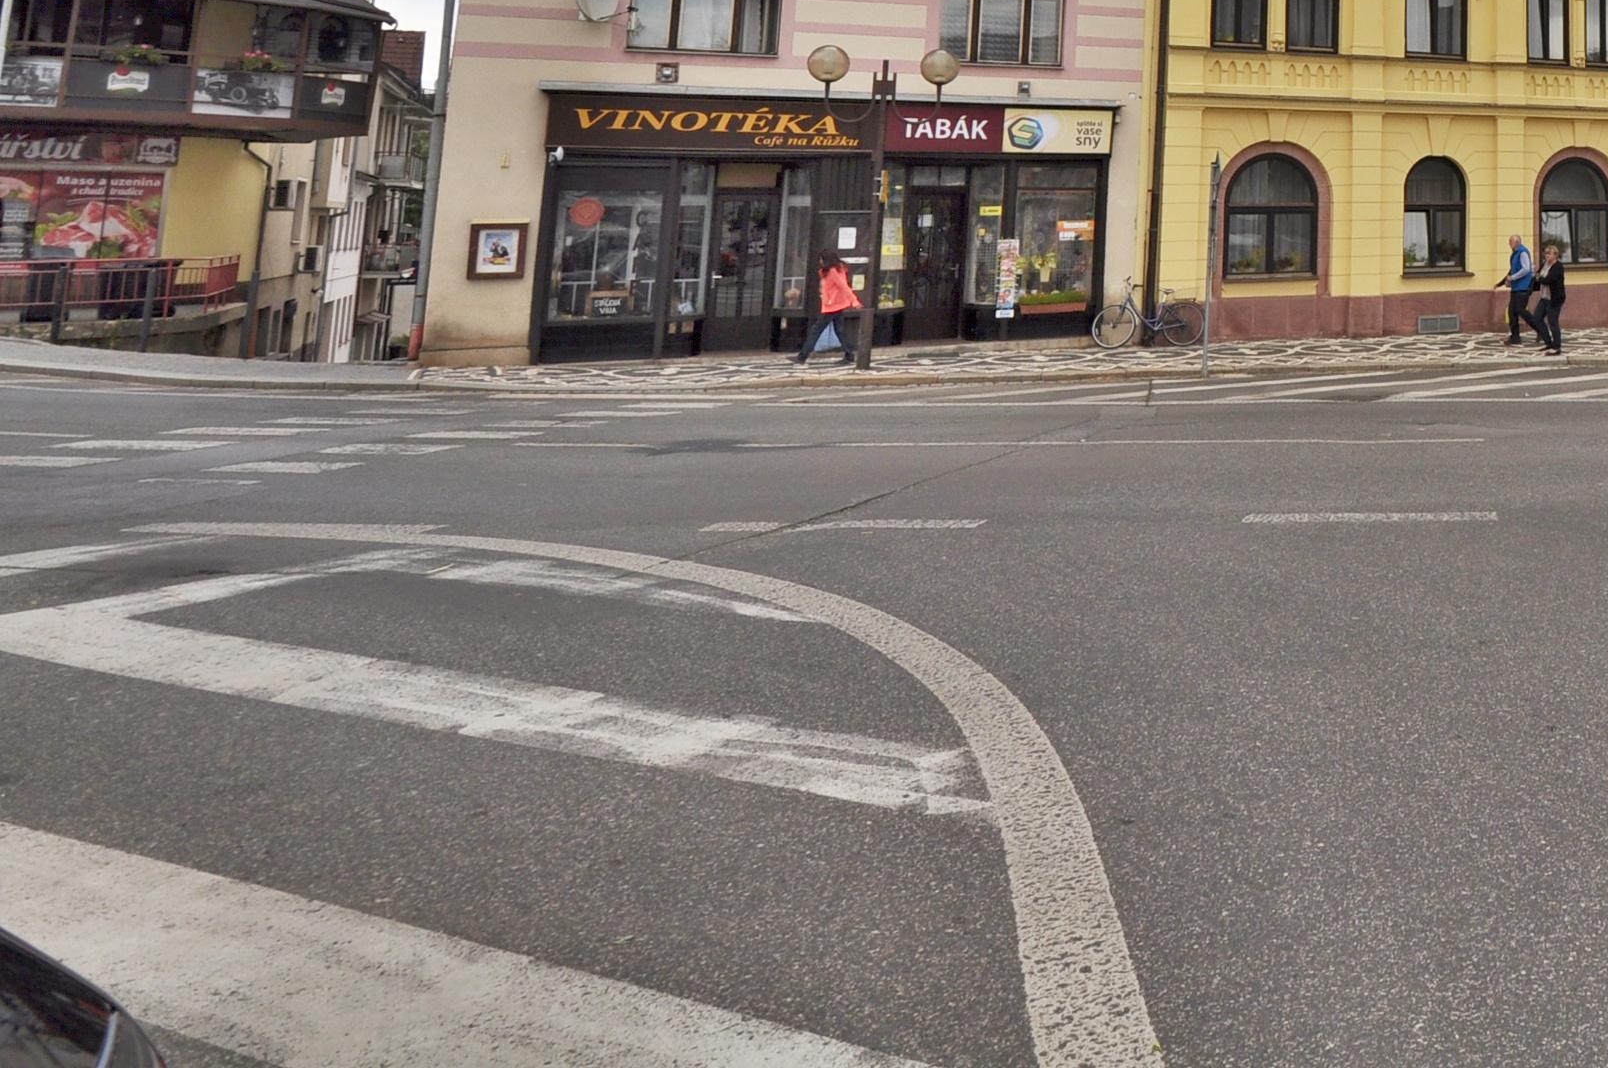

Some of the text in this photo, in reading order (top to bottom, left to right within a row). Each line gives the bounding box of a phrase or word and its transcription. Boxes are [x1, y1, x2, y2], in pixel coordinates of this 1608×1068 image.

[574, 108, 840, 134] VINOTÉKA
[903, 115, 989, 140] TABÁK
[754, 135, 860, 147] Café na Růžku
[1076, 136, 1101, 149] sny
[56, 176, 161, 187] Maso a uzenina
